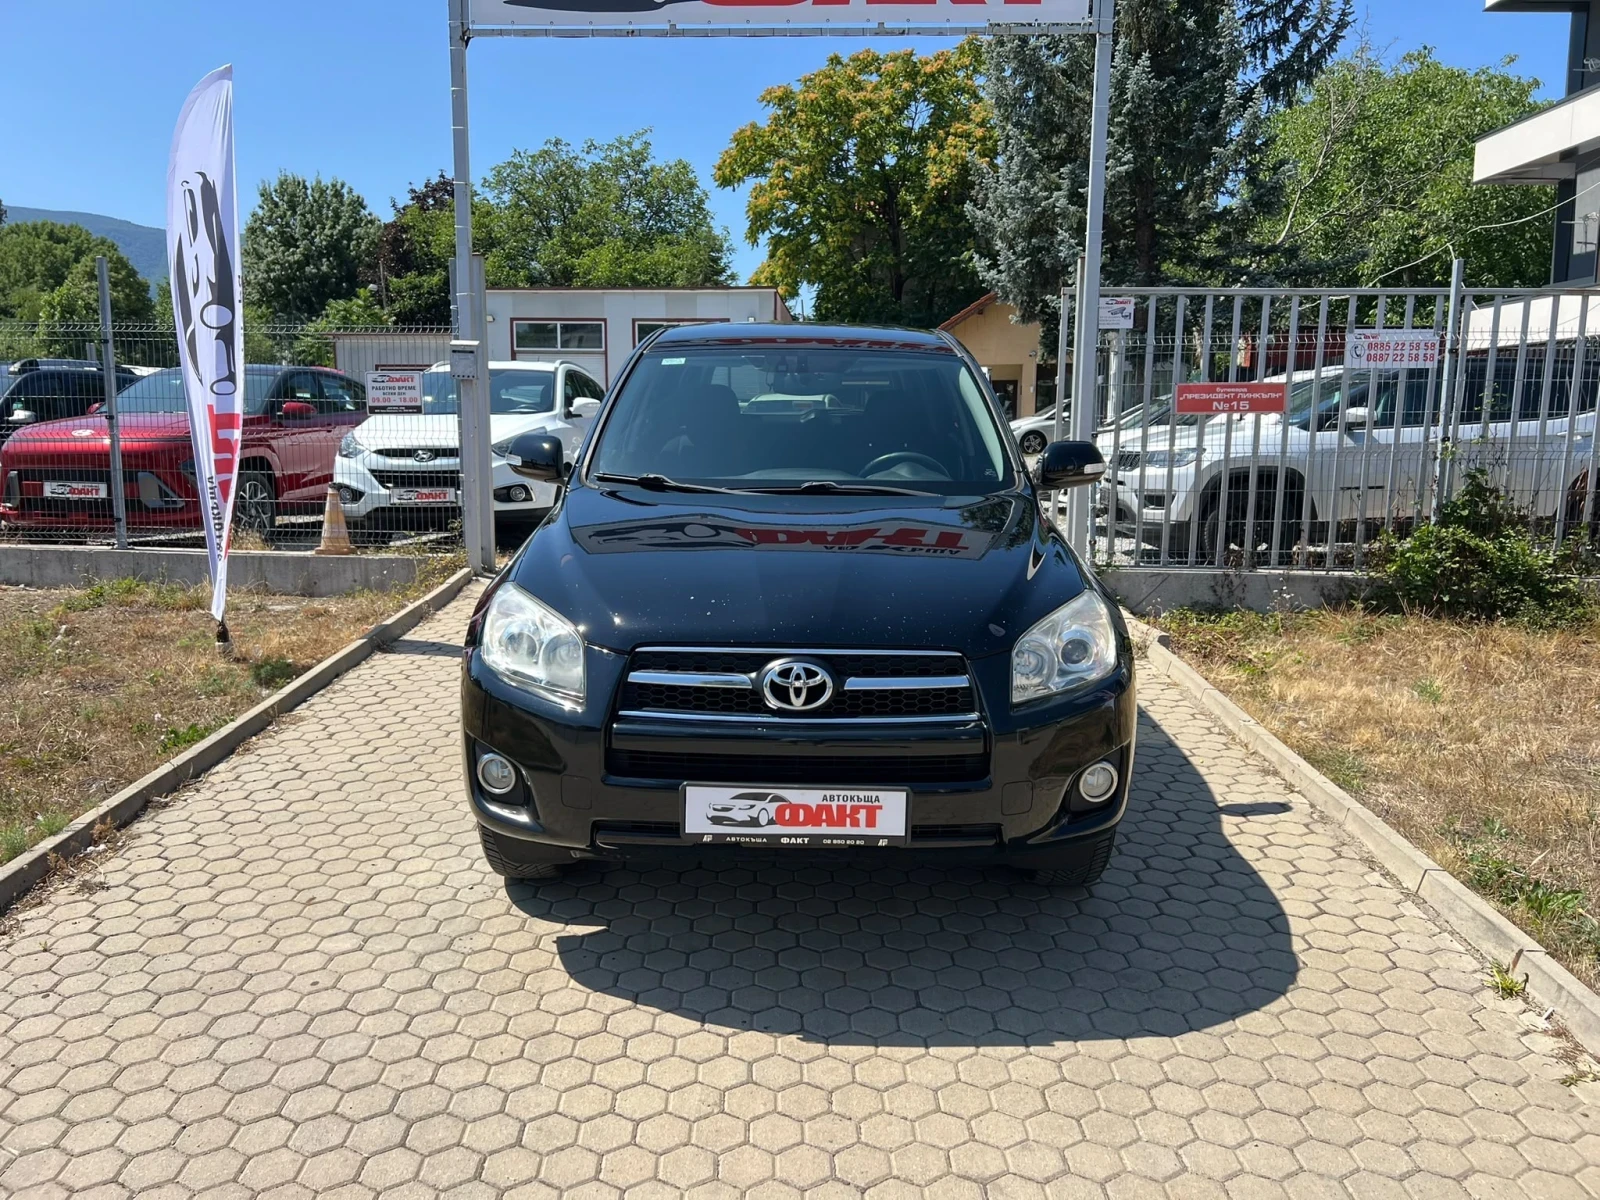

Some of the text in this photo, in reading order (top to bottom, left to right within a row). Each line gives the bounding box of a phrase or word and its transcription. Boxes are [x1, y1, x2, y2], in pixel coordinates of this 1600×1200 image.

[1367, 342, 1436, 351] 0885 22 58 58
[1366, 353, 1435, 362] 0887 22 58 58
[68, 487, 100, 496] ФАКТ
[416, 492, 448, 500] ФАКТ
[821, 794, 880, 804] АВТОКЪЩА
[775, 803, 883, 828] ФАКТ
